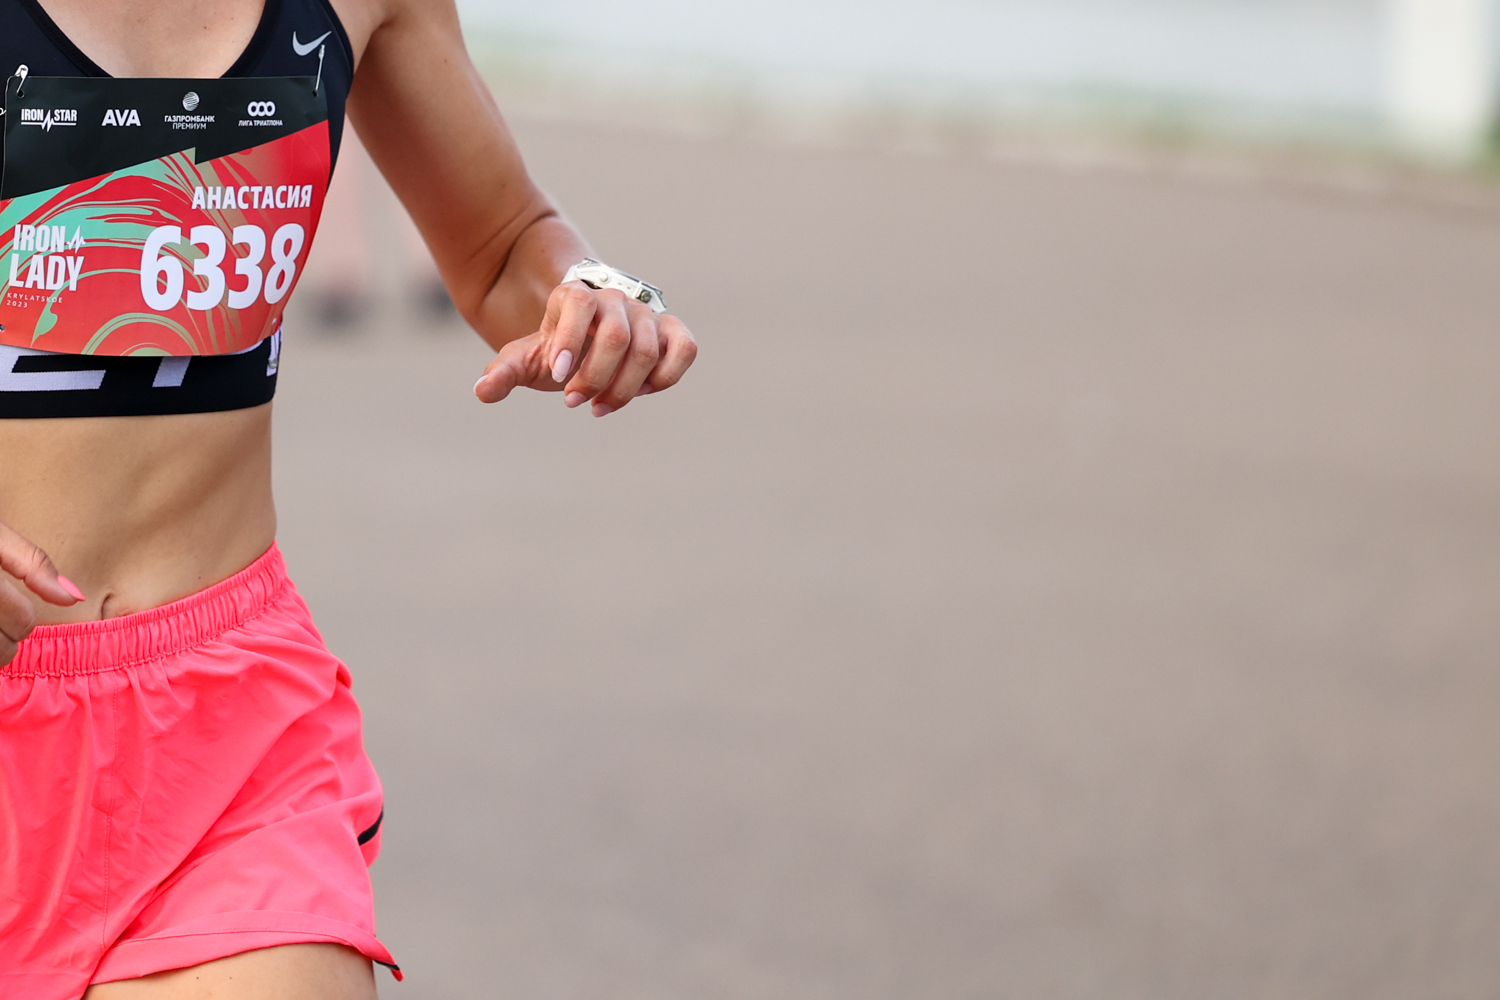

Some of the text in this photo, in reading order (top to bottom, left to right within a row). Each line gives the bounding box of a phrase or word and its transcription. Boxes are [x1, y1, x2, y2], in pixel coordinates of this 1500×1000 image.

[21, 108, 77, 122] IRON STAR
[101, 109, 141, 126] AVA
[164, 115, 215, 123] ГАЗПРОМБАНК
[172, 122, 207, 130] ПРЕМИУМ
[253, 119, 283, 127] ТРИАТЛОНА
[191, 184, 313, 210] АНАСТАСИЯ
[12, 223, 66, 253] IRON
[8, 252, 85, 292] LADY
[140, 223, 305, 312] 6338
[6, 292, 64, 304] KRYLATSKOE
[6, 299, 29, 308] 2023
